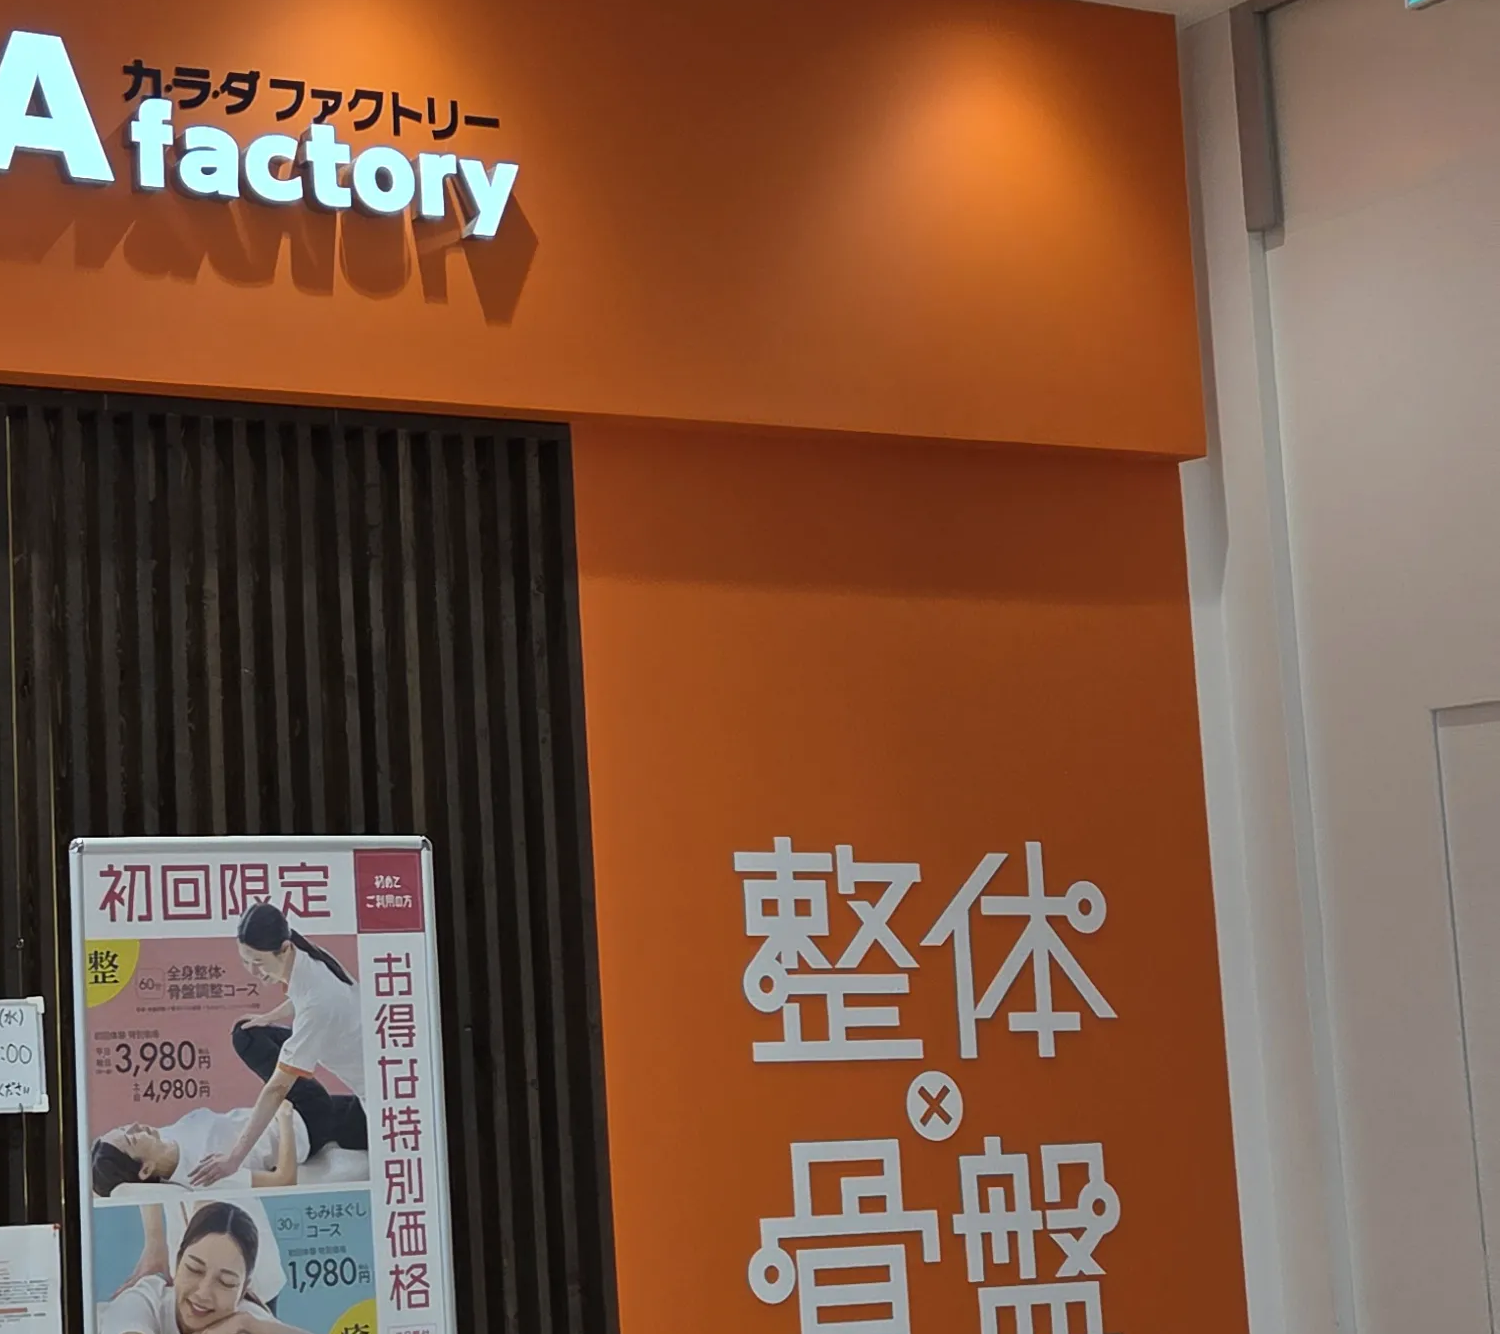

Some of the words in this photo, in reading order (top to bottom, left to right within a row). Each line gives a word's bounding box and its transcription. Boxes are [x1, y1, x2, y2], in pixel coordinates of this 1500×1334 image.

[130, 98, 519, 238] factory
[98, 862, 332, 923] 初回限定
[374, 874, 402, 889] 初めて
[365, 893, 413, 909] ご利用の方
[733, 837, 1119, 1062] 整体
[88, 950, 120, 985] 整
[167, 983, 260, 1000] 骨盤調整コース
[373, 952, 432, 1311] お得な特別価格
[305, 1202, 367, 1220] もみほぐし
[306, 1223, 342, 1238] コース
